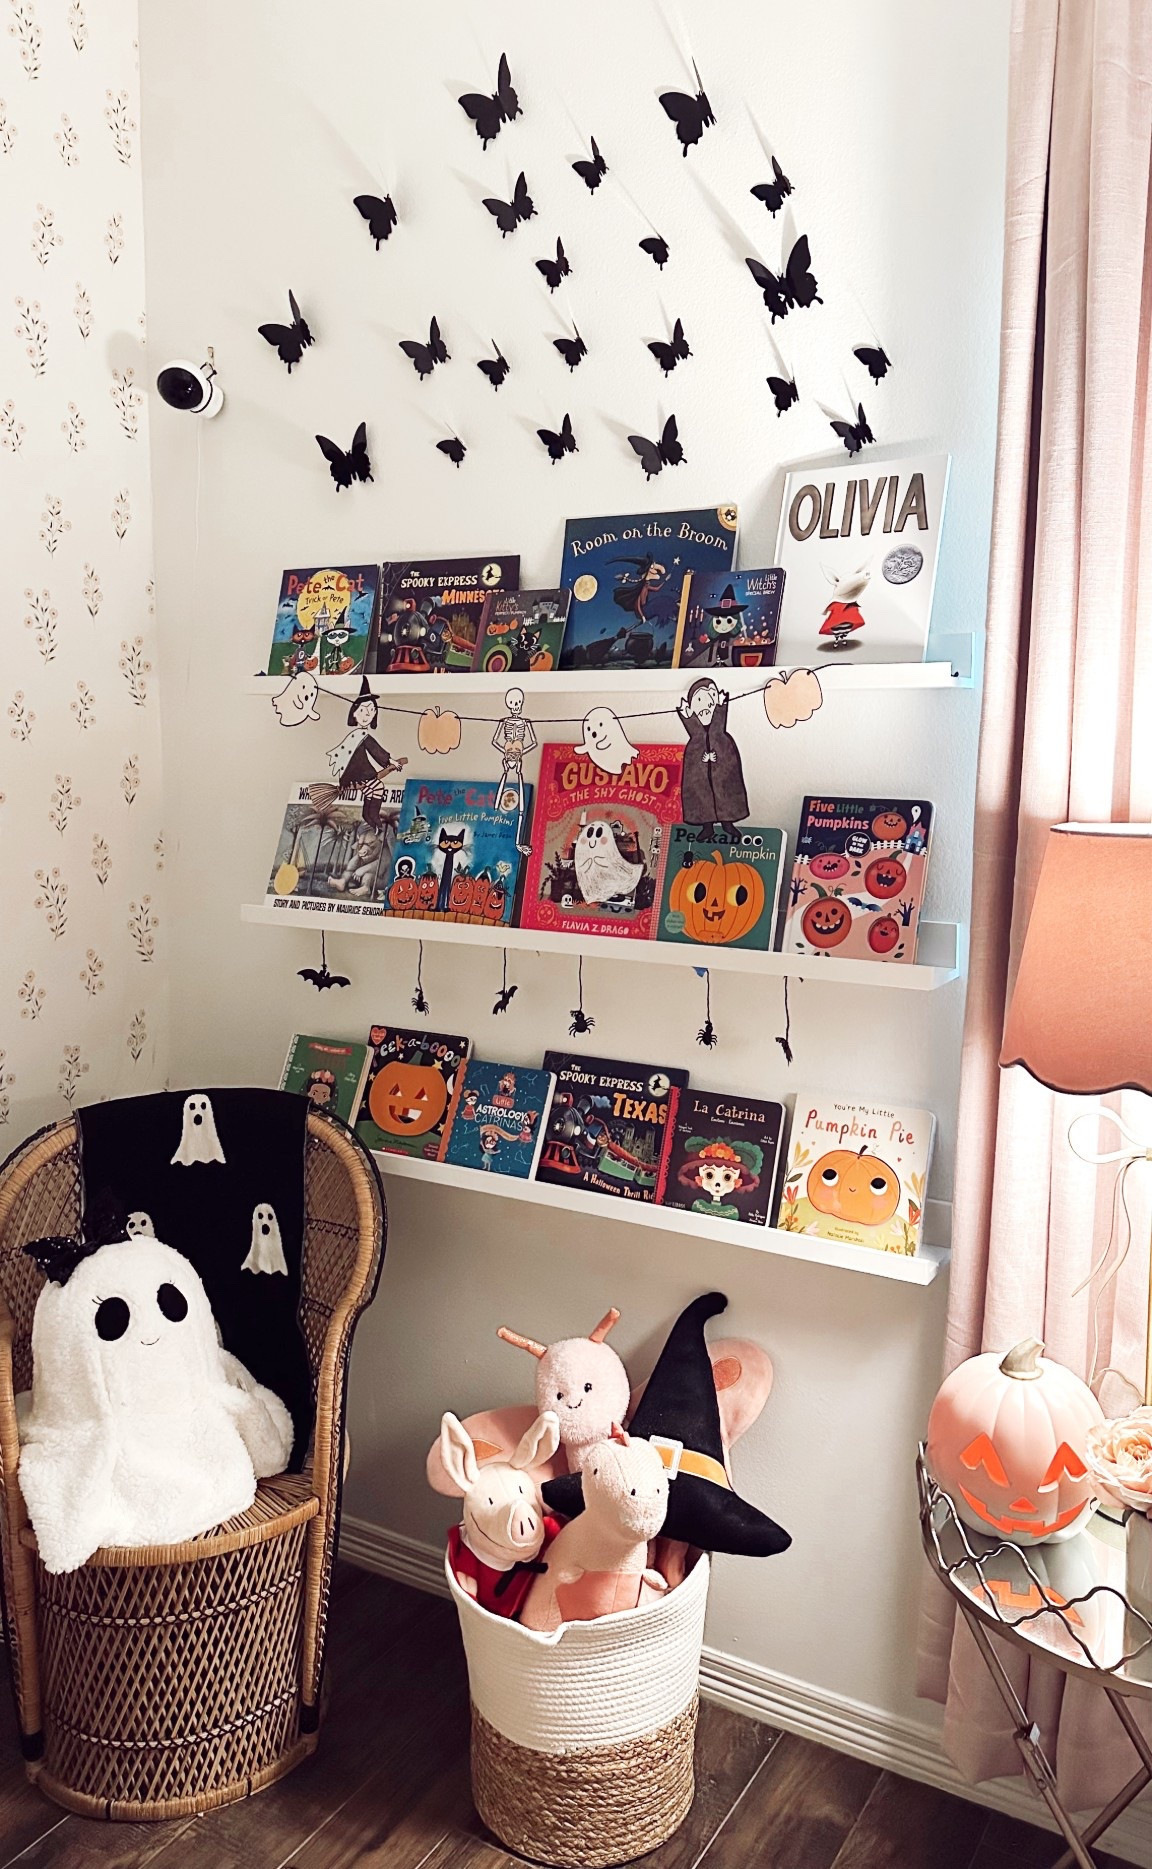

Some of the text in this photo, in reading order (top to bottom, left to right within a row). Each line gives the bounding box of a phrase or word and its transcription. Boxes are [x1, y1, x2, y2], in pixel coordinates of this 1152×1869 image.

[789, 473, 928, 541] OLIVIA
[571, 522, 728, 557] Room on the Broom
[287, 574, 364, 595] Pete the Cat
[401, 575, 478, 588] SPOOKY EXPRESS
[746, 578, 776, 591] Witch's
[305, 595, 321, 605] Trick
[330, 593, 344, 603] Pete
[442, 589, 505, 605] MINNES
[418, 785, 496, 807] Pete the Cat
[570, 787, 657, 804] THE SHY GHOST
[809, 800, 865, 814] Five Little
[455, 813, 478, 823] Little
[481, 812, 514, 826] Pumpkins
[807, 815, 870, 831] Pumpkins
[852, 835, 869, 844] GLOW
[729, 846, 776, 863] Pumpkin
[849, 846, 864, 854] DARK
[273, 899, 289, 908] STORY
[289, 900, 300, 909] AND
[301, 900, 327, 911] PICTURES
[327, 903, 335, 912] BY
[336, 903, 361, 914] MAURICE
[562, 920, 590, 932] FLAVIA
[601, 926, 630, 935] DRAGO
[560, 1070, 643, 1092] SPOOKY EXPRESS
[476, 1104, 528, 1122] ASTROLOGY
[613, 1092, 668, 1124] TEXAS
[694, 1100, 765, 1123] La Catrina
[834, 1103, 895, 1119] You're My Little
[475, 1113, 523, 1131] CATRINAS
[805, 1109, 915, 1145] Pumpkin Pie
[583, 1172, 588, 1181] A
[590, 1174, 620, 1194] Halloween
[624, 1186, 640, 1199] Thrill
